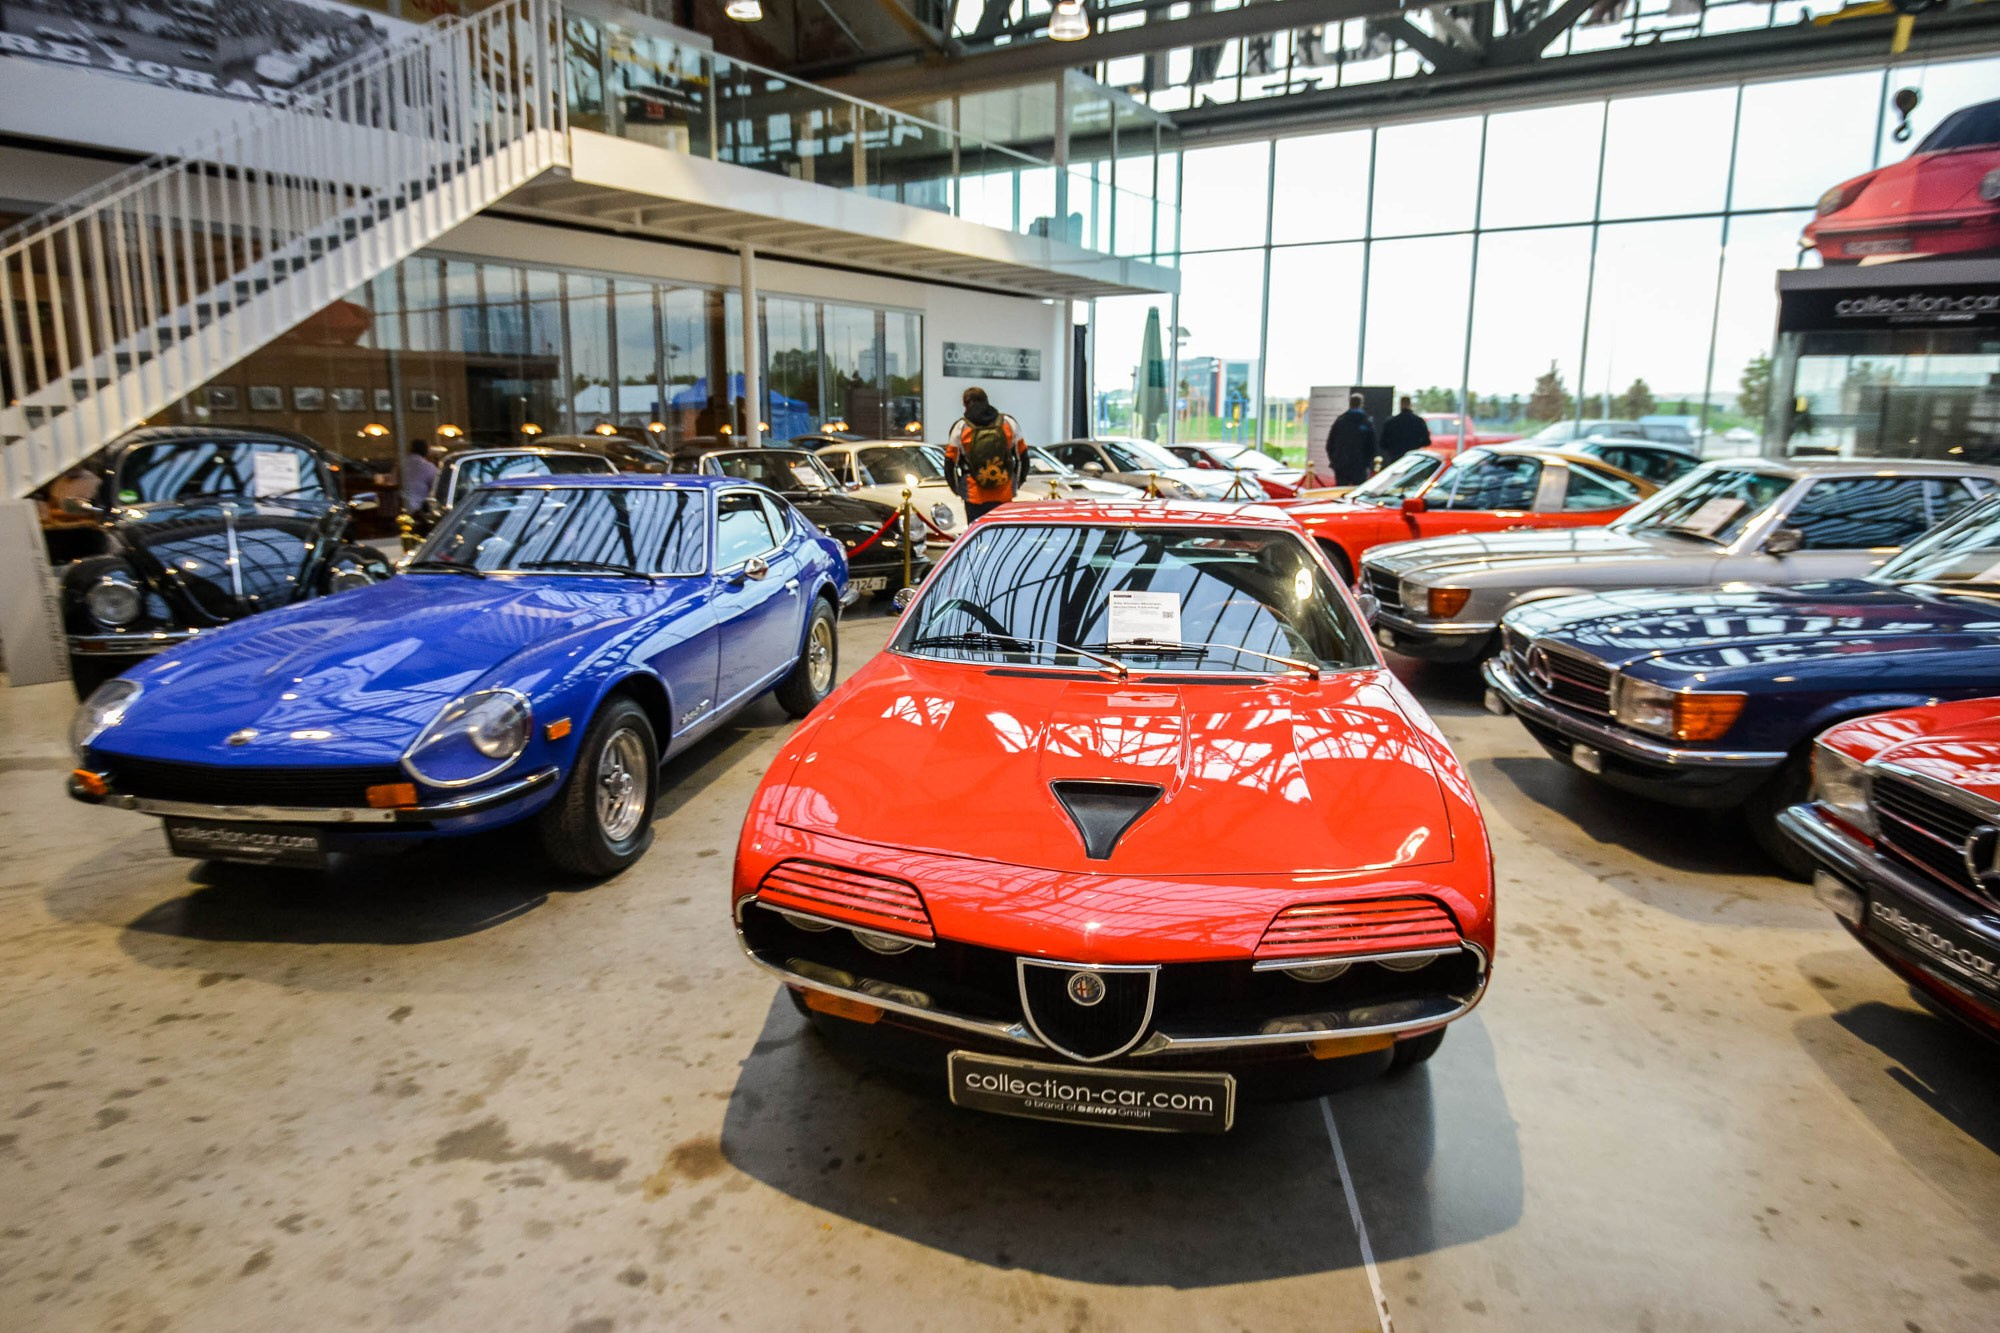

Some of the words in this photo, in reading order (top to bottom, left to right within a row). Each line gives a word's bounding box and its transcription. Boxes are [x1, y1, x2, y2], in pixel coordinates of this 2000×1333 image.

[945, 346, 1039, 368] collection-car.com
[172, 827, 319, 848] collection-car.com
[965, 1072, 1213, 1112] collection-car.com
[1024, 1099, 1032, 1107] a
[1034, 1099, 1064, 1112] brand
[1066, 1103, 1077, 1112] of
[1077, 1104, 1117, 1116] SEMO
[1118, 1107, 1151, 1118] GmbH
